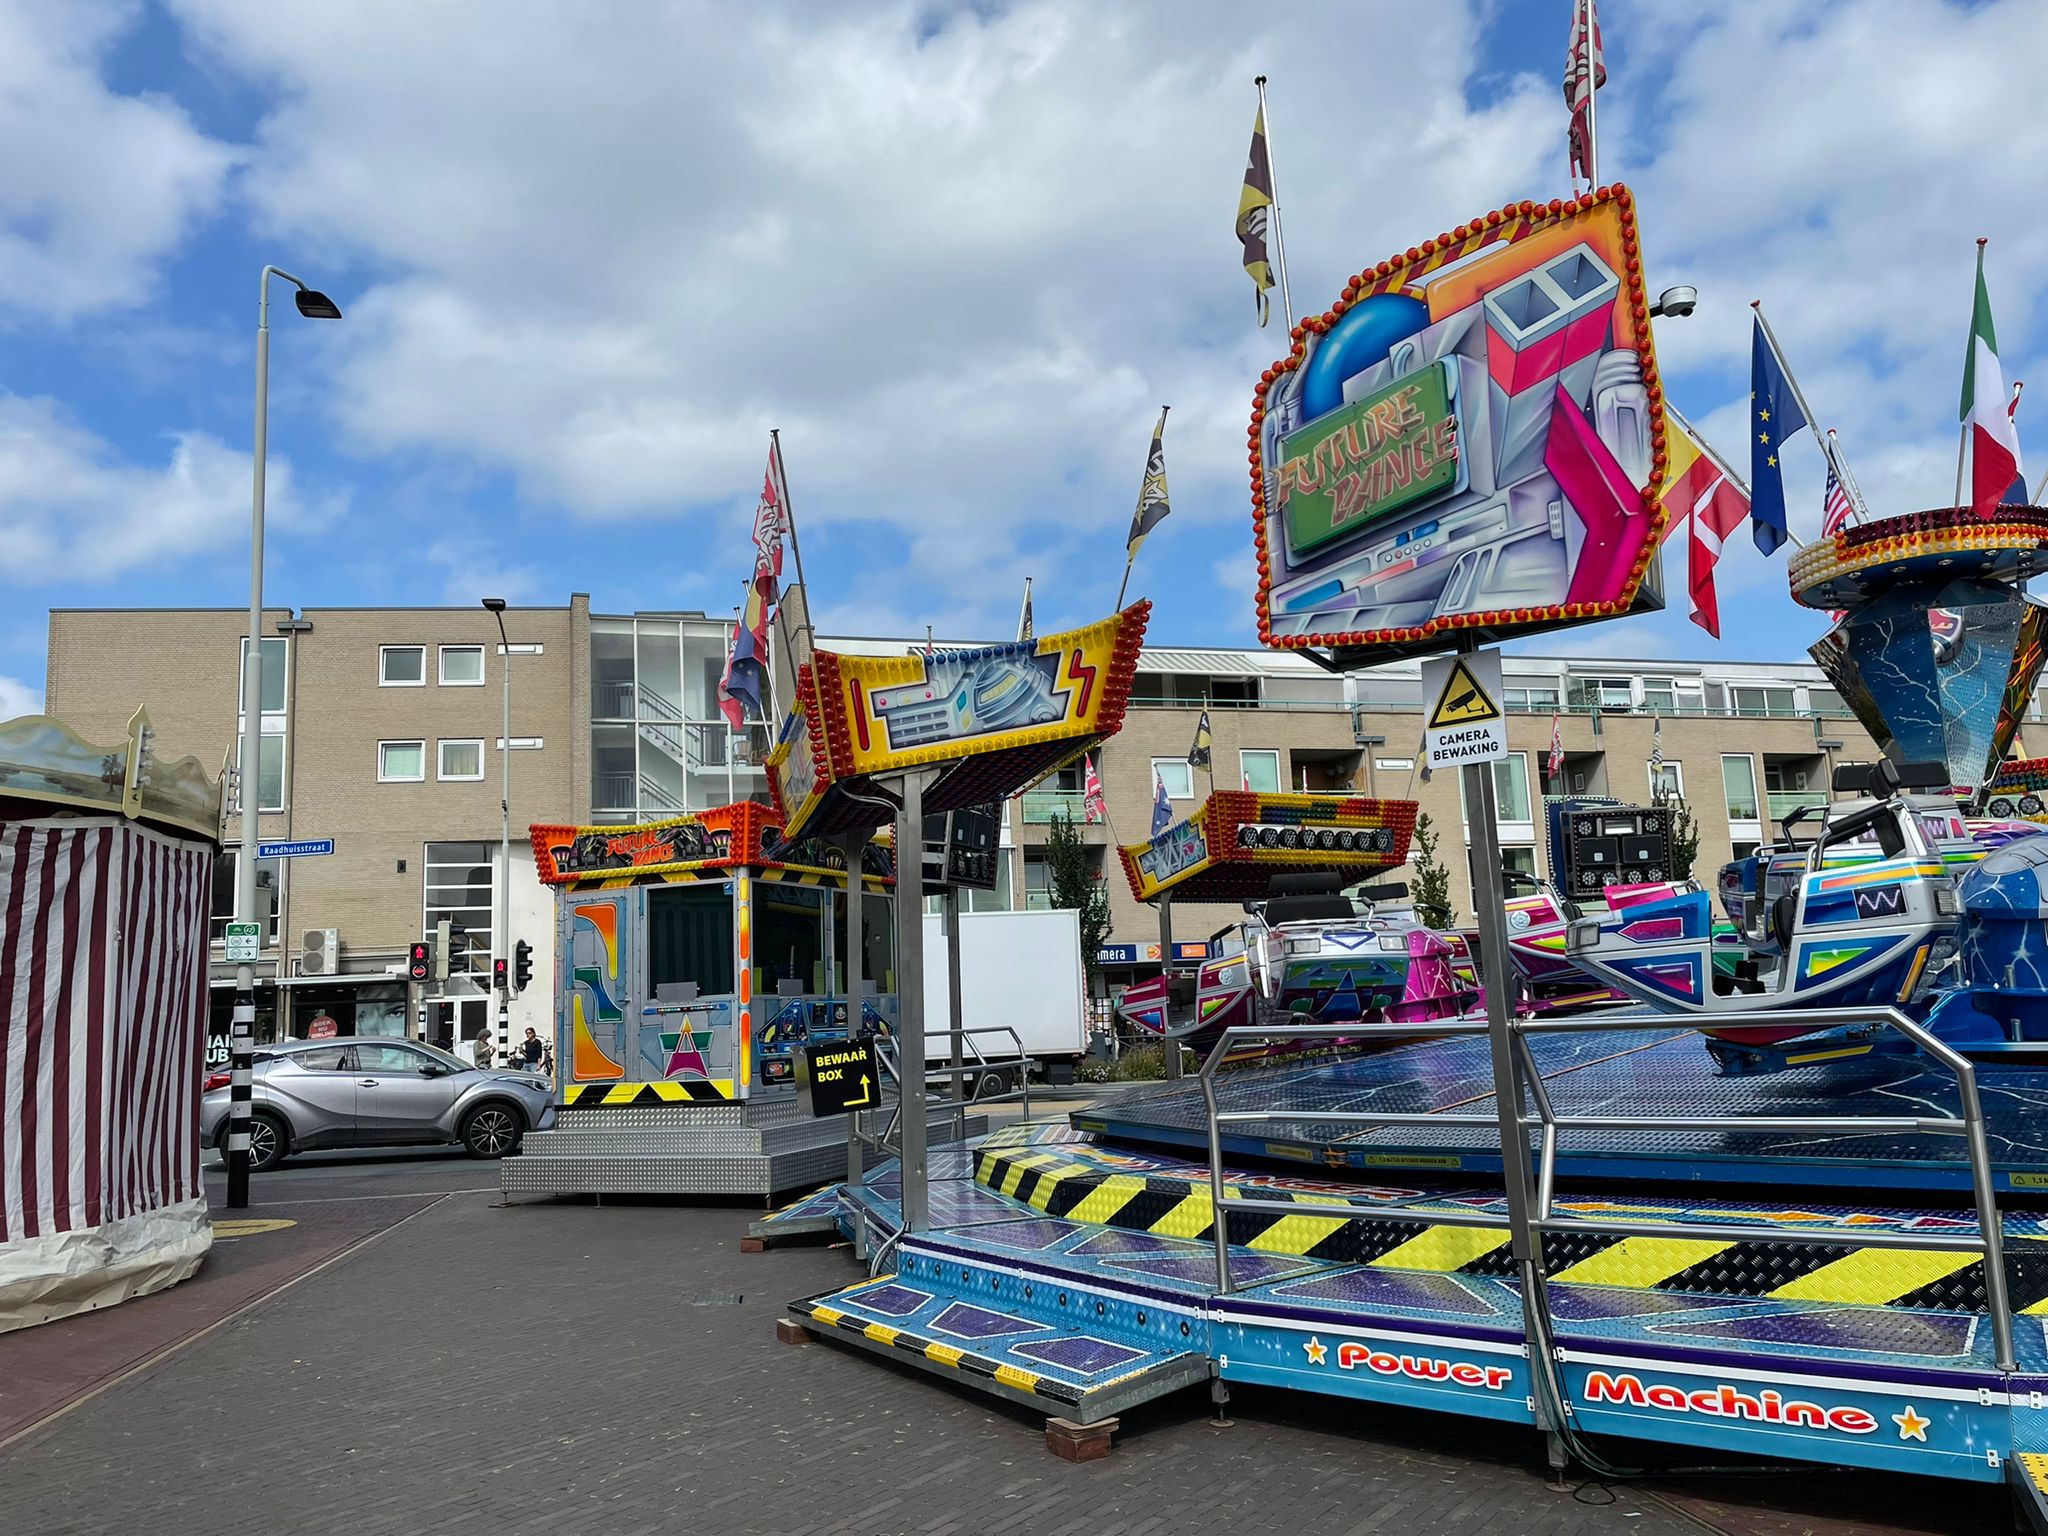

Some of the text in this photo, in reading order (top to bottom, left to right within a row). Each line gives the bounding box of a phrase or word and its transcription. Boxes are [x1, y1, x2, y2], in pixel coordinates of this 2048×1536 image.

[1271, 385, 1424, 512] FUTURE
[1324, 414, 1459, 527] DANCE
[1439, 729, 1491, 746] CAMERA
[1433, 741, 1499, 761] BEWAKING
[264, 844, 326, 855] Raadhuisstraat
[815, 1050, 868, 1067] BEWAAR
[817, 1069, 844, 1083] BOX
[1337, 1342, 1880, 1434] Power Machine
